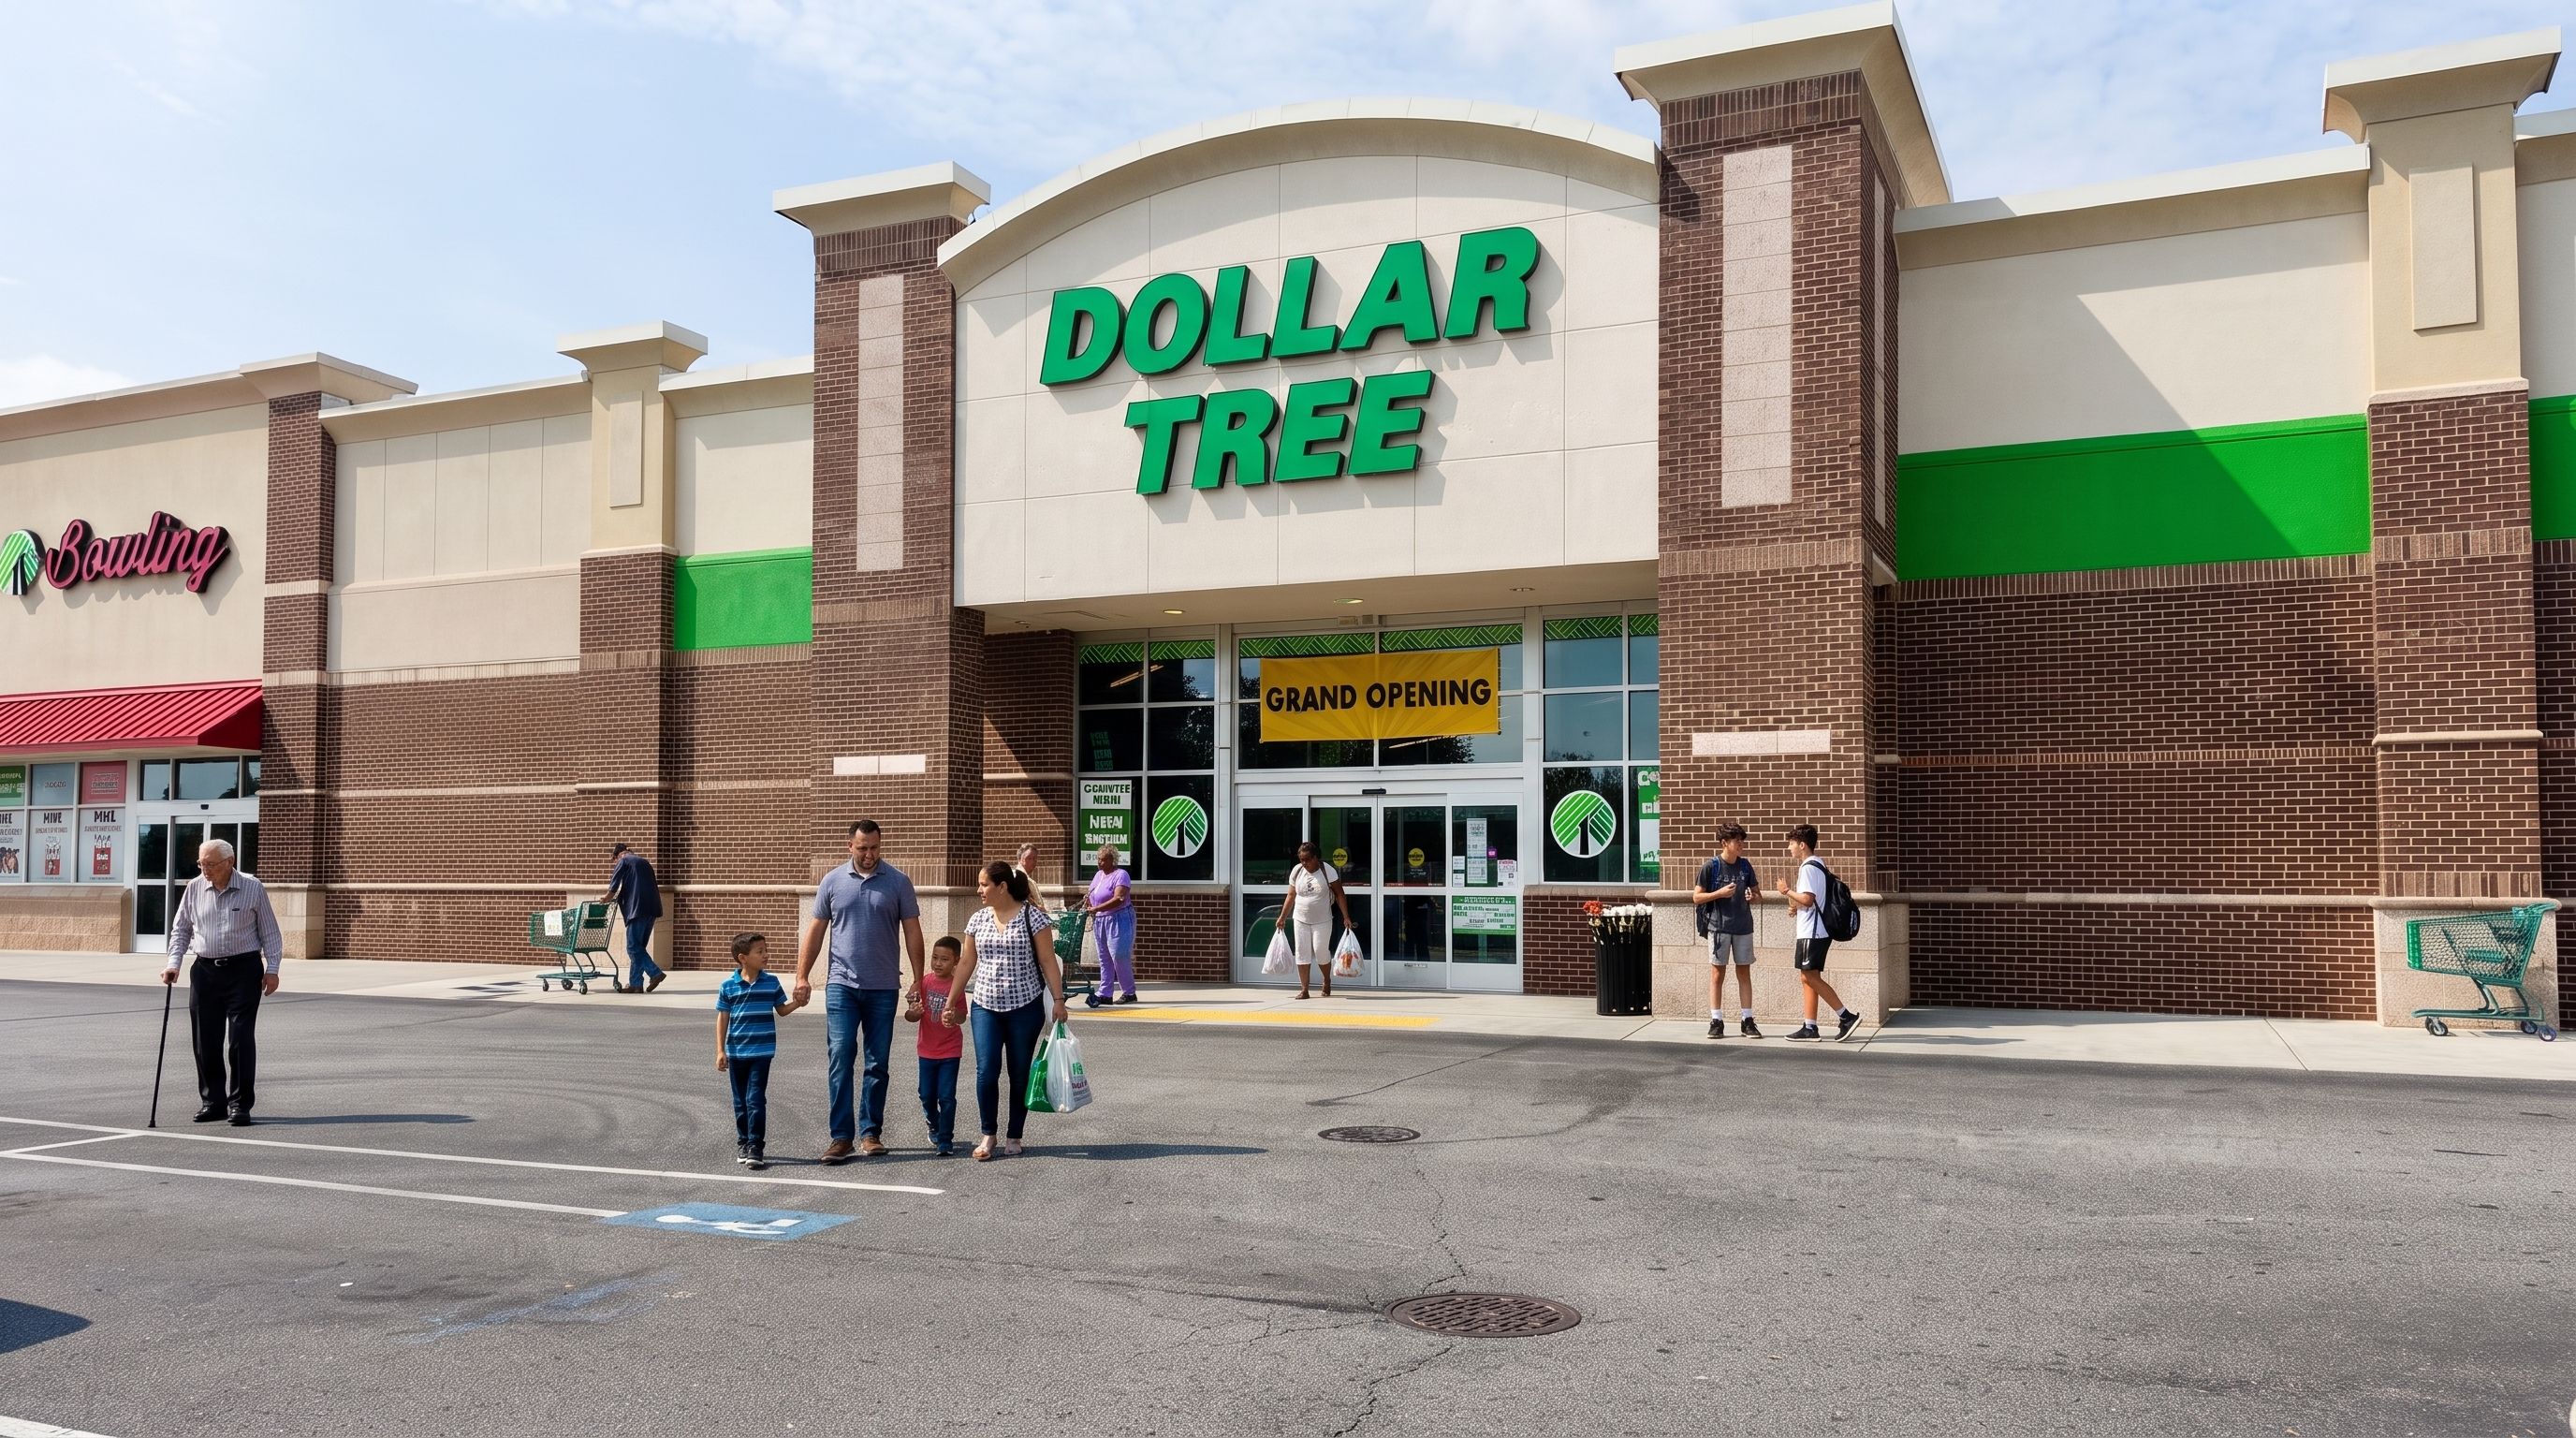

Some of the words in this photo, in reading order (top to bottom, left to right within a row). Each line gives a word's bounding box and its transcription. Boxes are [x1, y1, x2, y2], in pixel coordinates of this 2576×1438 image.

[1039, 227, 1542, 387] DOLLAR
[1123, 369, 1436, 496] TREE
[45, 510, 231, 594] Bowling
[1266, 684, 1357, 712] GRAND
[1366, 678, 1492, 709] OPENING
